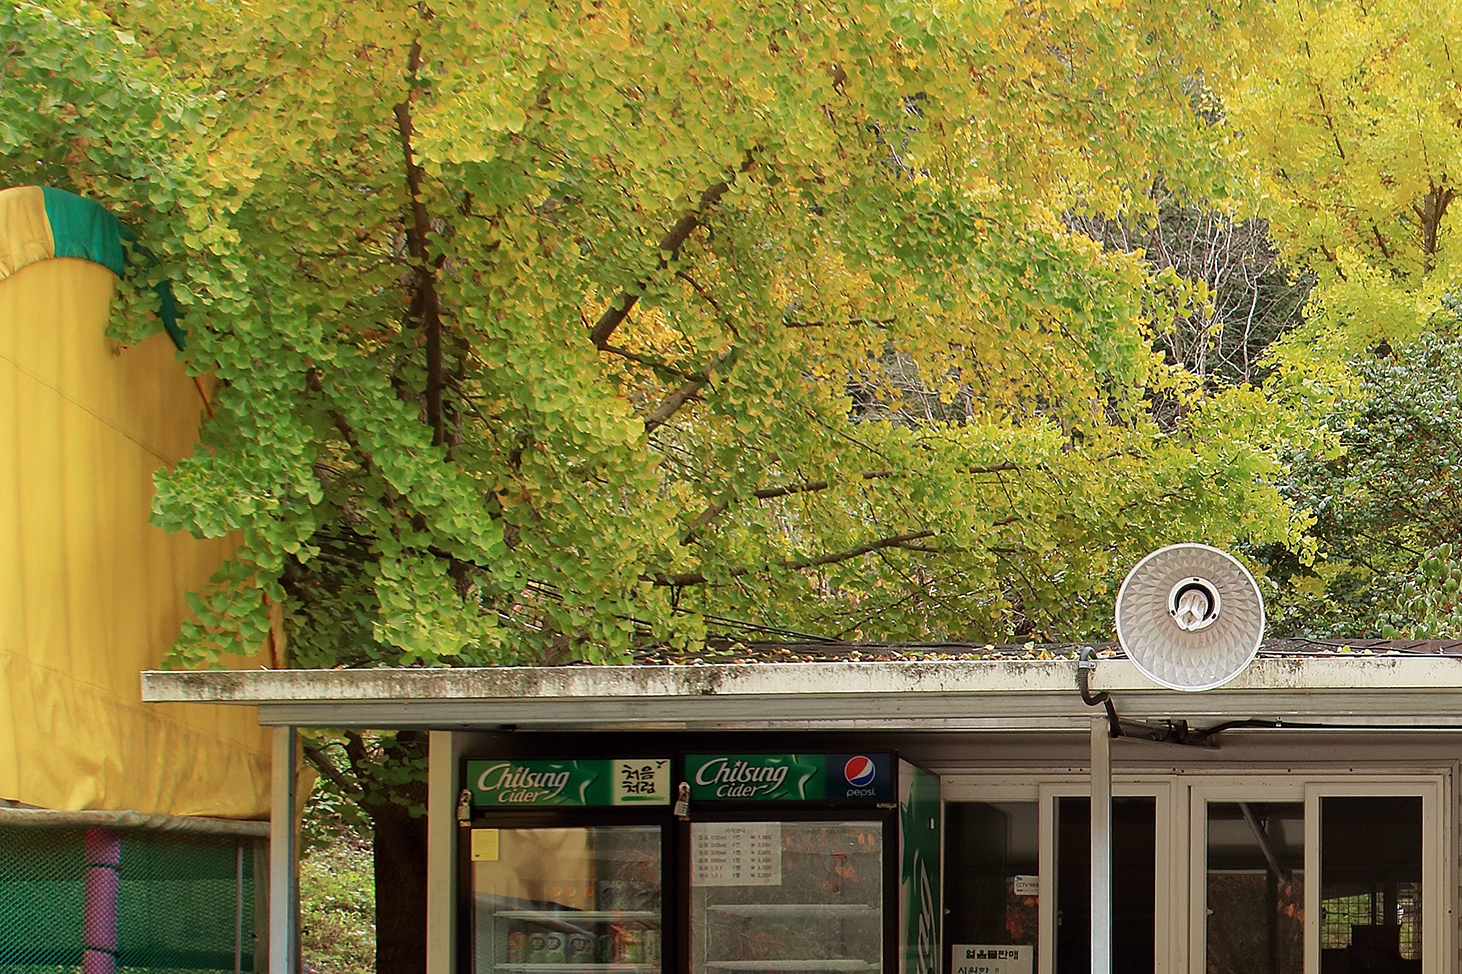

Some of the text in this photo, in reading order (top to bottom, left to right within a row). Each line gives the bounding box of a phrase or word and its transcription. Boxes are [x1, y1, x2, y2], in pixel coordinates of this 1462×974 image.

[621, 764, 656, 780] 처음
[695, 757, 789, 795] Chilsung
[477, 763, 570, 799] Chilsung
[621, 781, 656, 794] 처럼
[846, 788, 875, 797] pepsi
